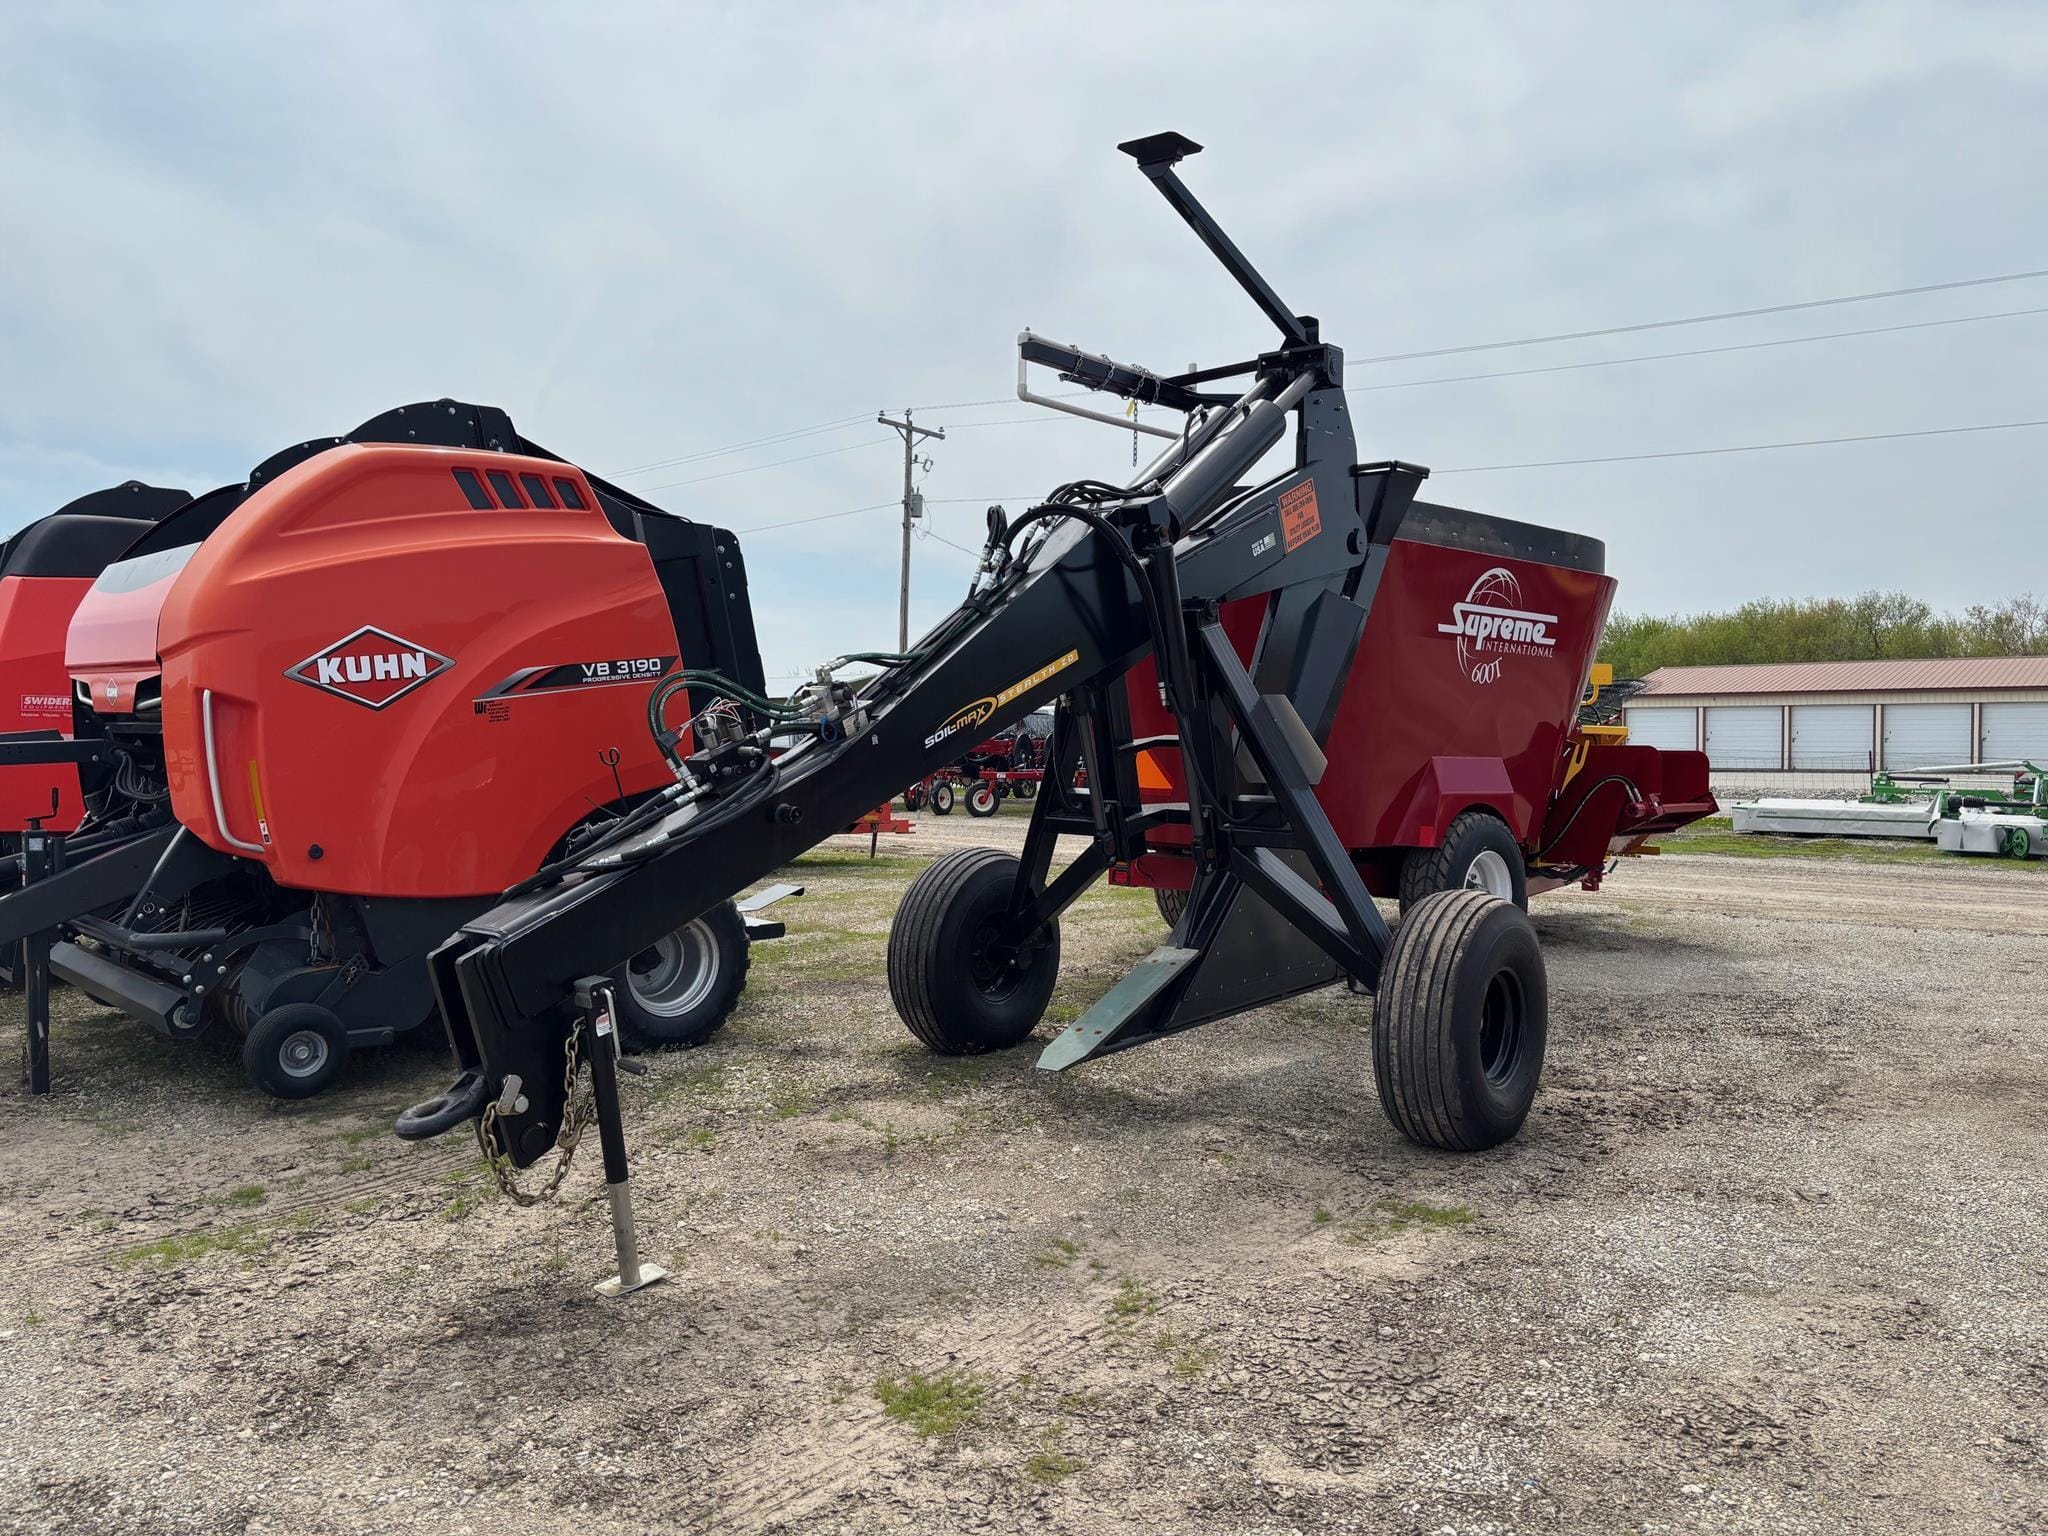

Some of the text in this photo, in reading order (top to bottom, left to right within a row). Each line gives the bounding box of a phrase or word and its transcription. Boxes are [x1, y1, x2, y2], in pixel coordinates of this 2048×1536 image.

[1281, 483, 1312, 506] WARNING
[1252, 544, 1265, 556] USA
[1438, 602, 1558, 650] Supreme
[1482, 640, 1553, 658] INTERNATIONAL
[316, 652, 427, 685] KUHN
[581, 658, 661, 677] VB 3190
[582, 671, 661, 683] PROGRESSIVE DENSITY
[1471, 656, 1502, 684] 600T
[999, 665, 1056, 703] STEALTH
